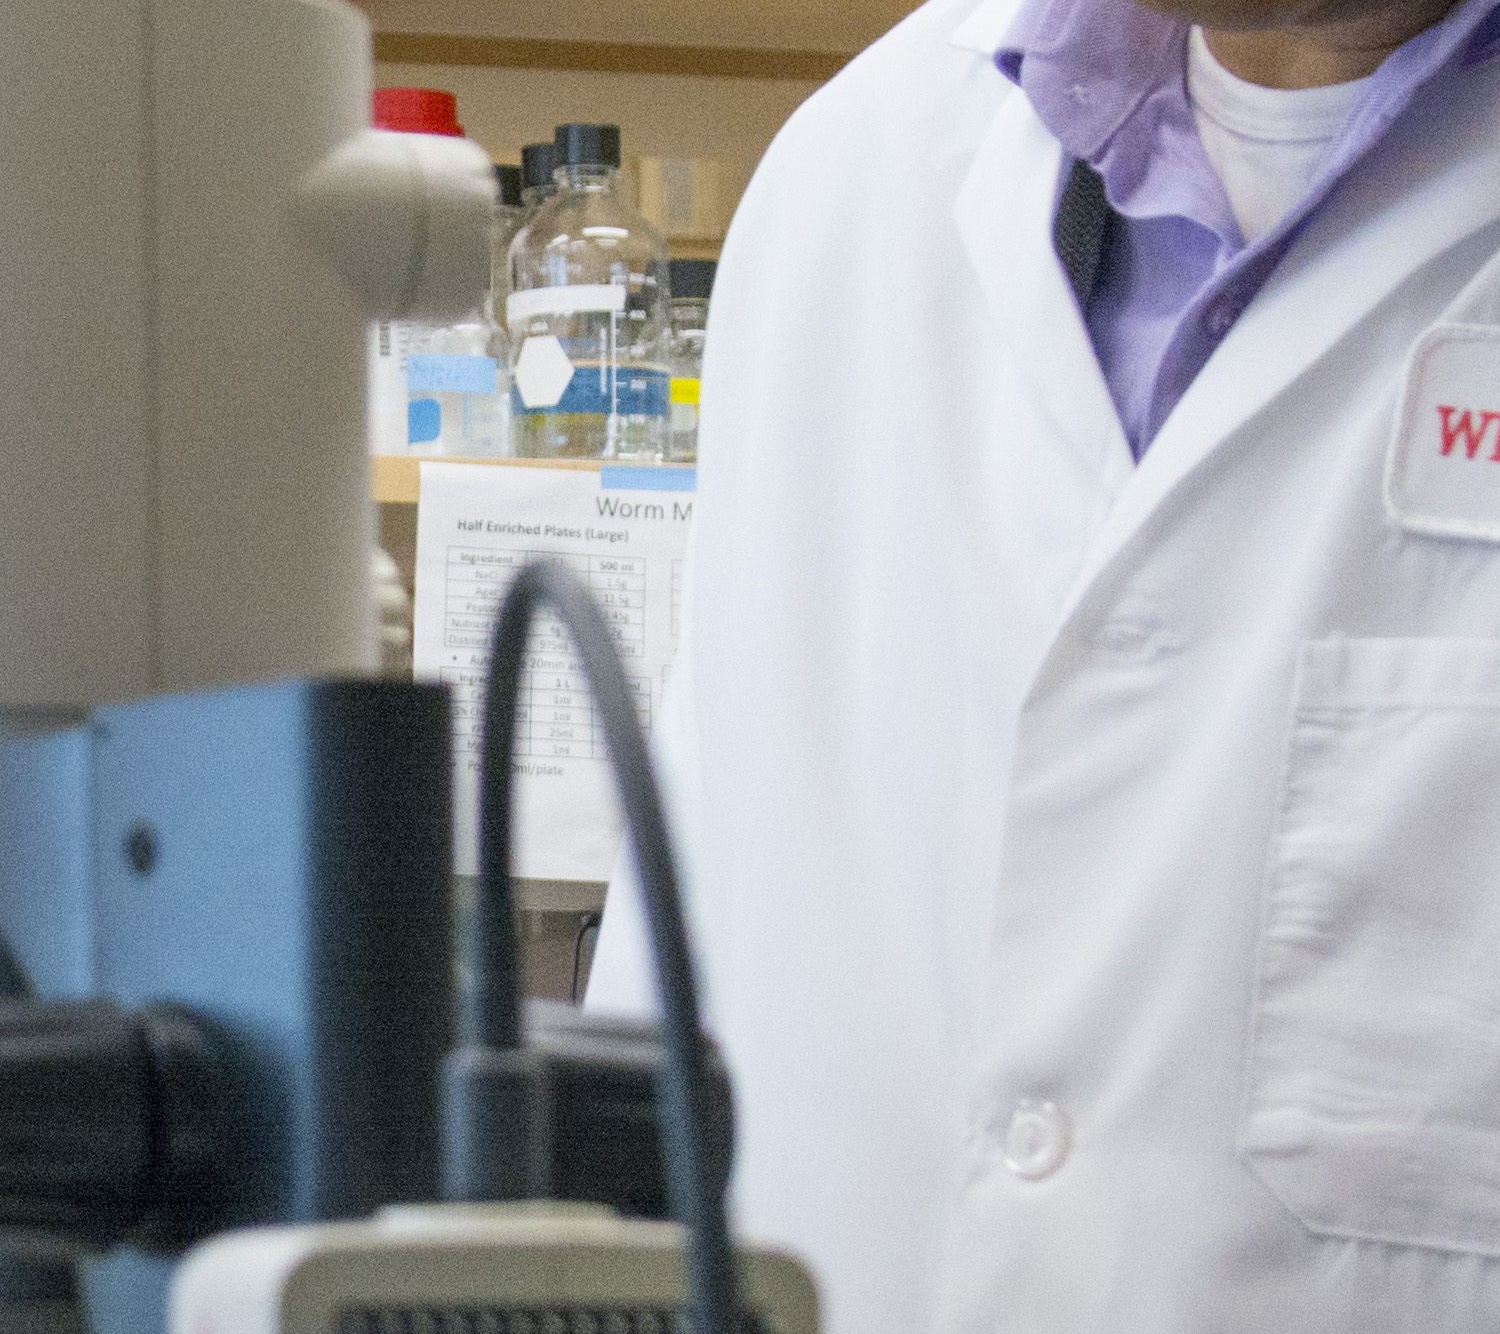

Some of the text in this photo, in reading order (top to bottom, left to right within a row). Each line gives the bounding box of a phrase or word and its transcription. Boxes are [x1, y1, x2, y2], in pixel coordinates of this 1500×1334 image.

[596, 496, 665, 520] Worm
[457, 519, 630, 543] Half Enriched Plates (Large)
[460, 553, 636, 573] Ingredient 500 ml
